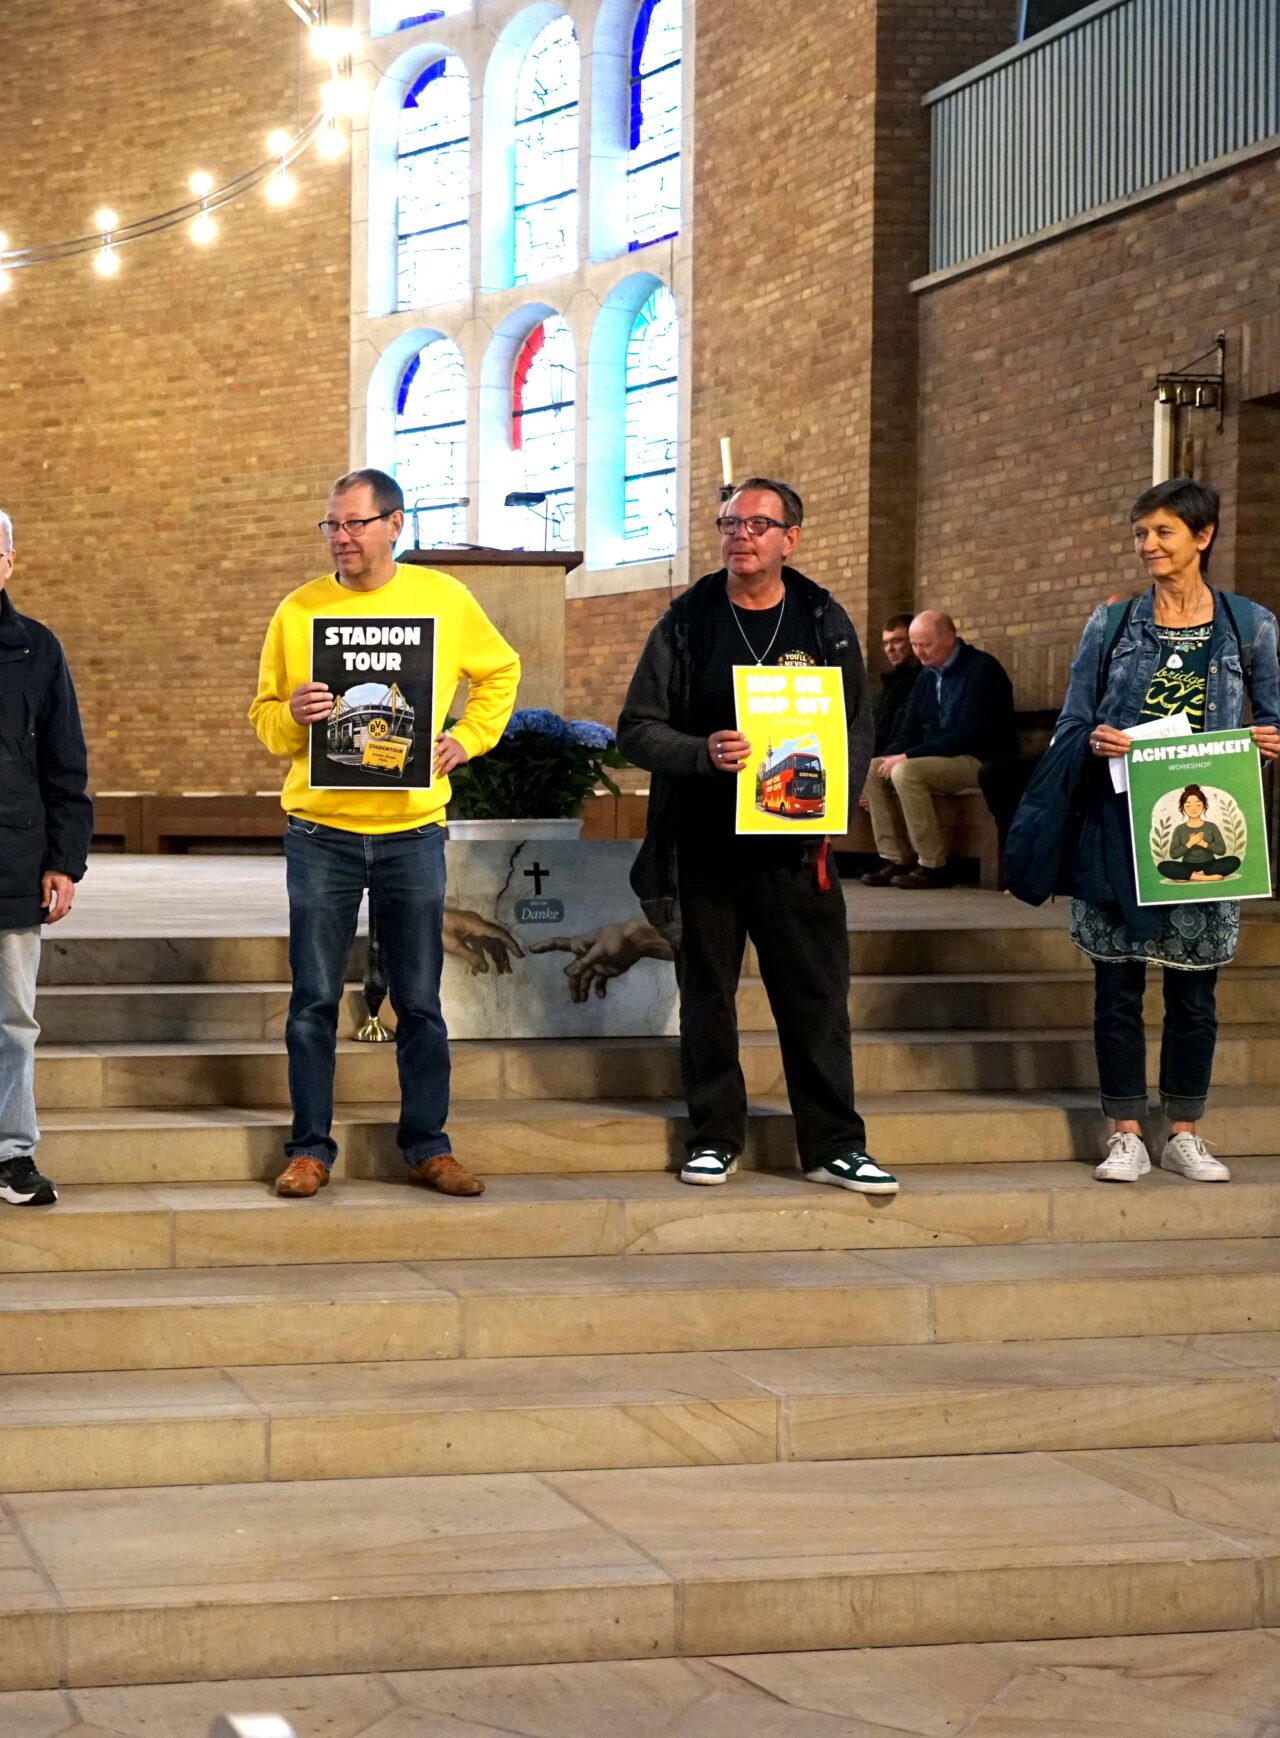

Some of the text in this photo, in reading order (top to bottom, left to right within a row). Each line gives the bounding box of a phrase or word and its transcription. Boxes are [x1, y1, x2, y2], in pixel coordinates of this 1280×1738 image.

[325, 626, 421, 646] STADION
[343, 652, 402, 671] TOUR
[747, 674, 822, 694] HOP ON
[748, 695, 831, 715] HOP OFF
[1132, 738, 1252, 763] ACHTSAMKEIT
[1168, 761, 1212, 771] WORKSHOP
[521, 908, 559, 920] Danke
